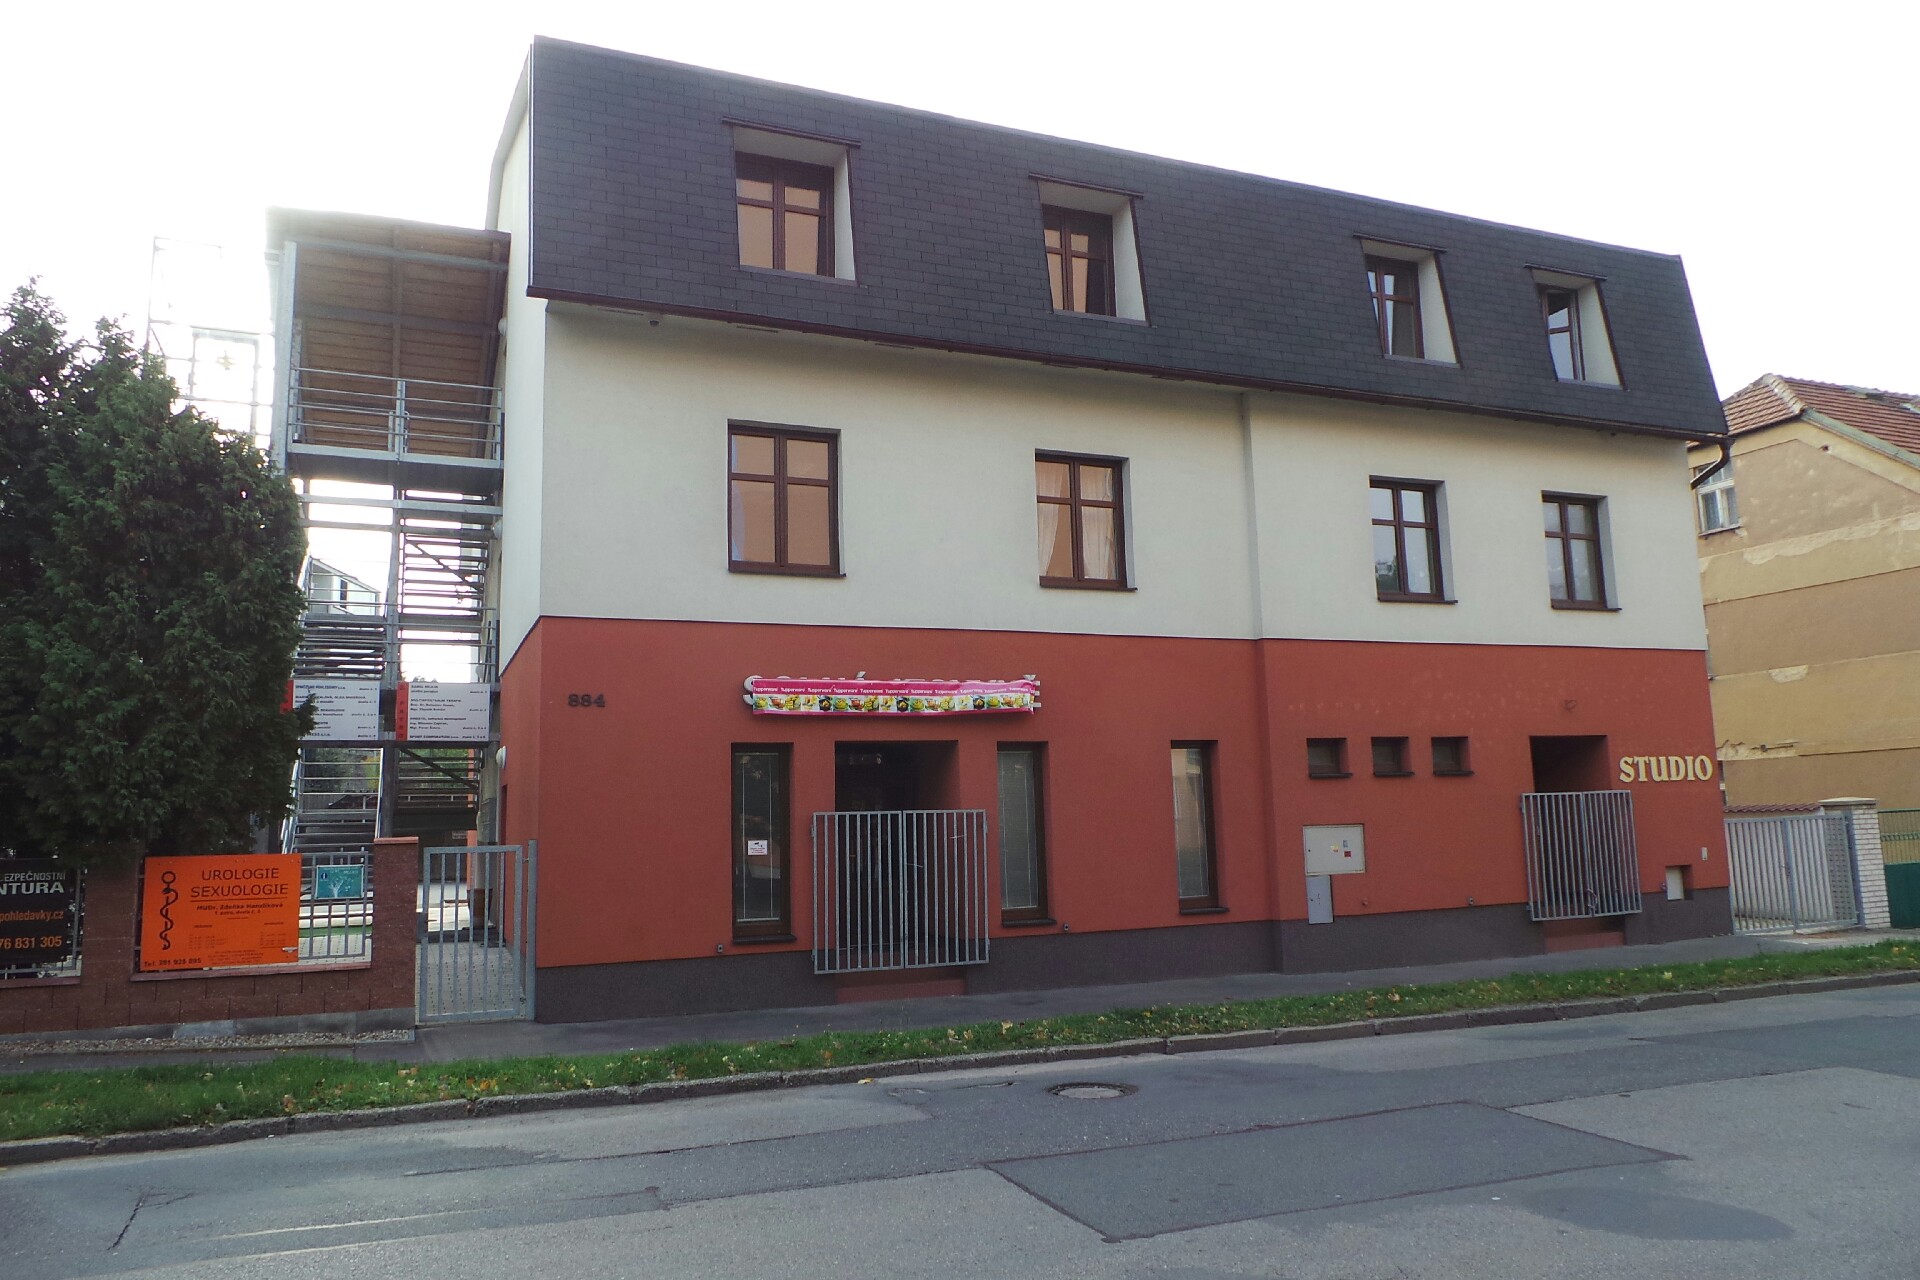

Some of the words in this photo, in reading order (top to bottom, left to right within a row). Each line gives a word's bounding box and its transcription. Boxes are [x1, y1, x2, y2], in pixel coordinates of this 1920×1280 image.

[568, 693, 606, 708] 884
[1619, 755, 1713, 783] STUDIO
[0, 870, 66, 882] EZPEČNOSTNÍ
[201, 868, 279, 881] UROLOGIE
[190, 883, 289, 898] SEXUOLOGIE
[15, 937, 36, 949] 831
[40, 936, 62, 948] 305
